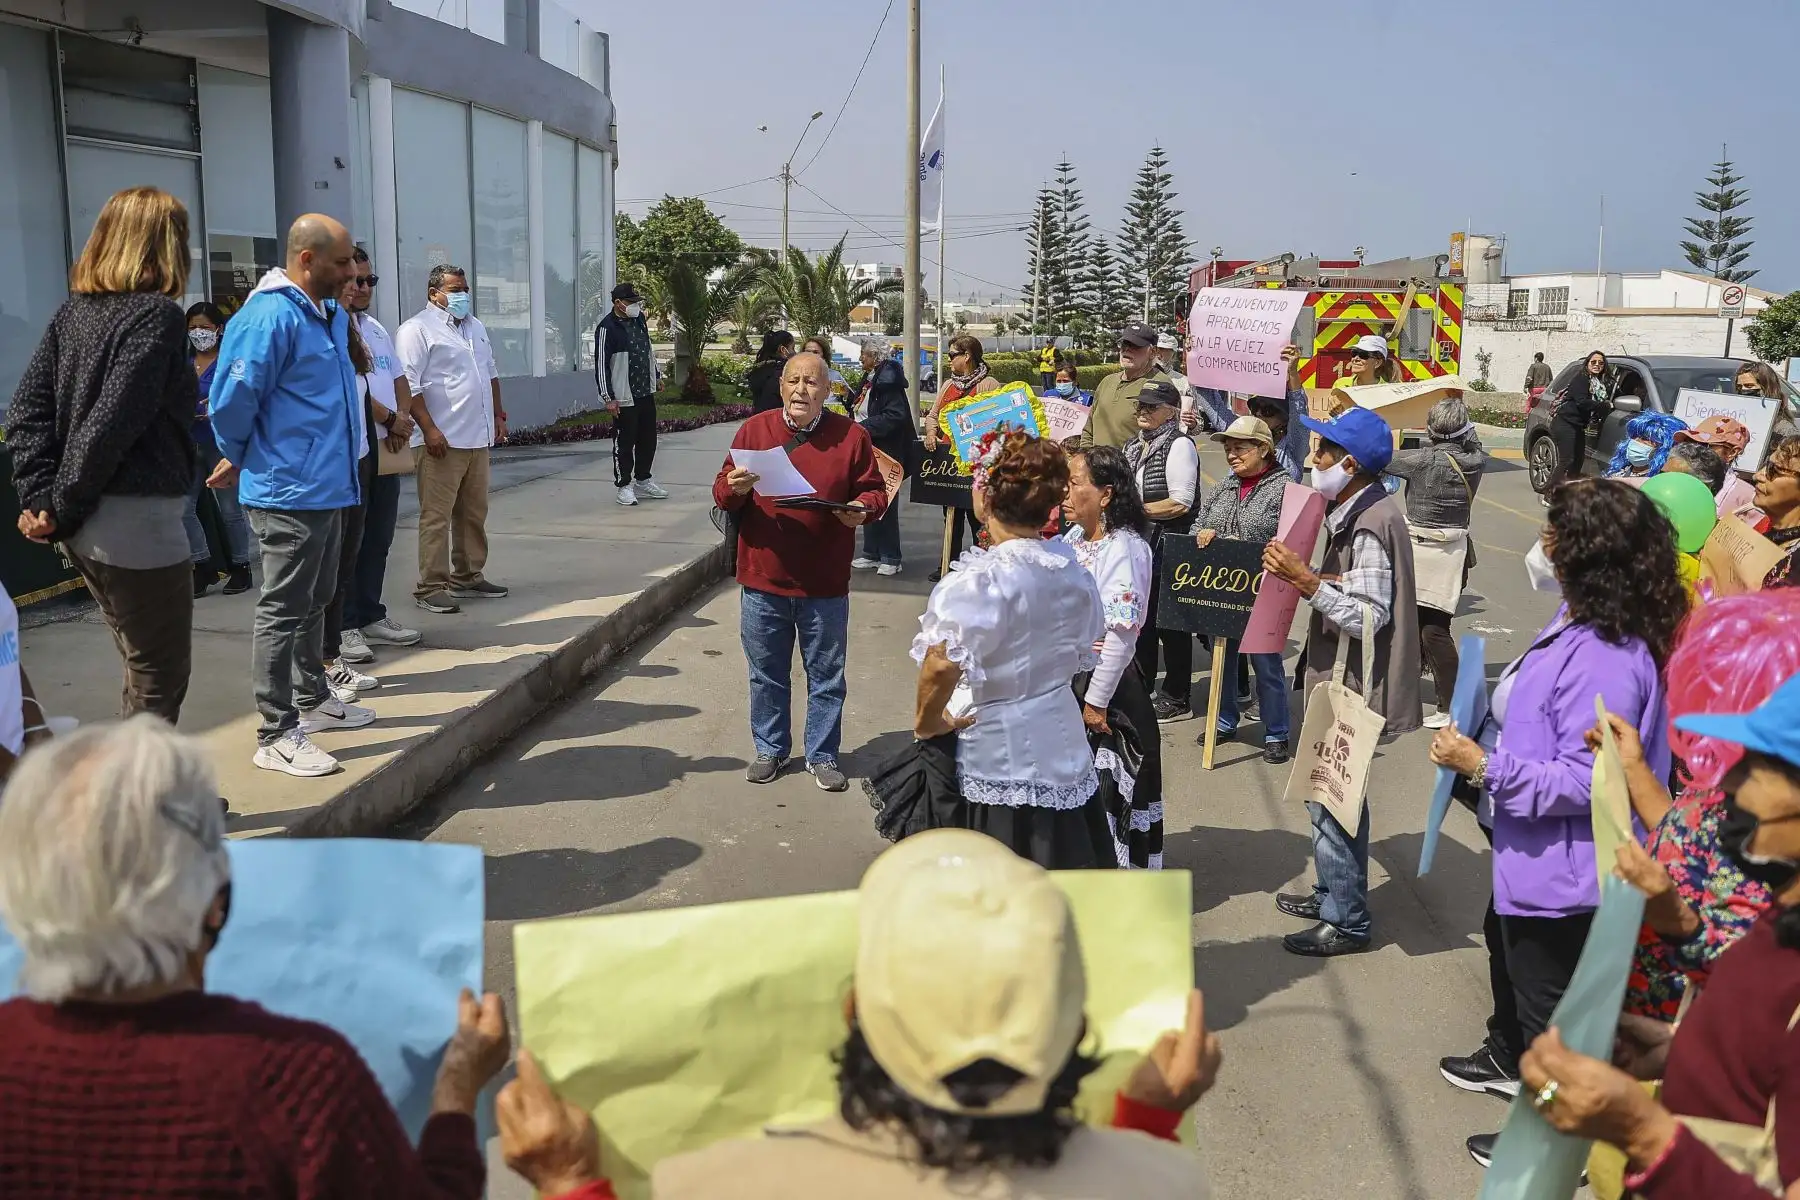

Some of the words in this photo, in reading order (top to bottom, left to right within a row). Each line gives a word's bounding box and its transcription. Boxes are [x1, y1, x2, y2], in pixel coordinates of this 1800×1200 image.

[1199, 295, 1214, 307] EN
[1214, 296, 1230, 308] LA
[1231, 298, 1289, 312] JUVENTUD
[1206, 314, 1282, 336] APRENDEMOS
[1191, 335, 1204, 349] EN
[1208, 336, 1221, 349] LA
[1226, 338, 1265, 355] VEJEZ
[1197, 355, 1280, 376] COMPRENDEMOS
[1042, 401, 1081, 420] ECEMOS
[1048, 416, 1075, 431] PETO
[920, 459, 958, 478] GAE
[1177, 596, 1196, 605] GRUPO
[1196, 599, 1220, 608] ADULTO
[1220, 602, 1236, 610] EDAD
